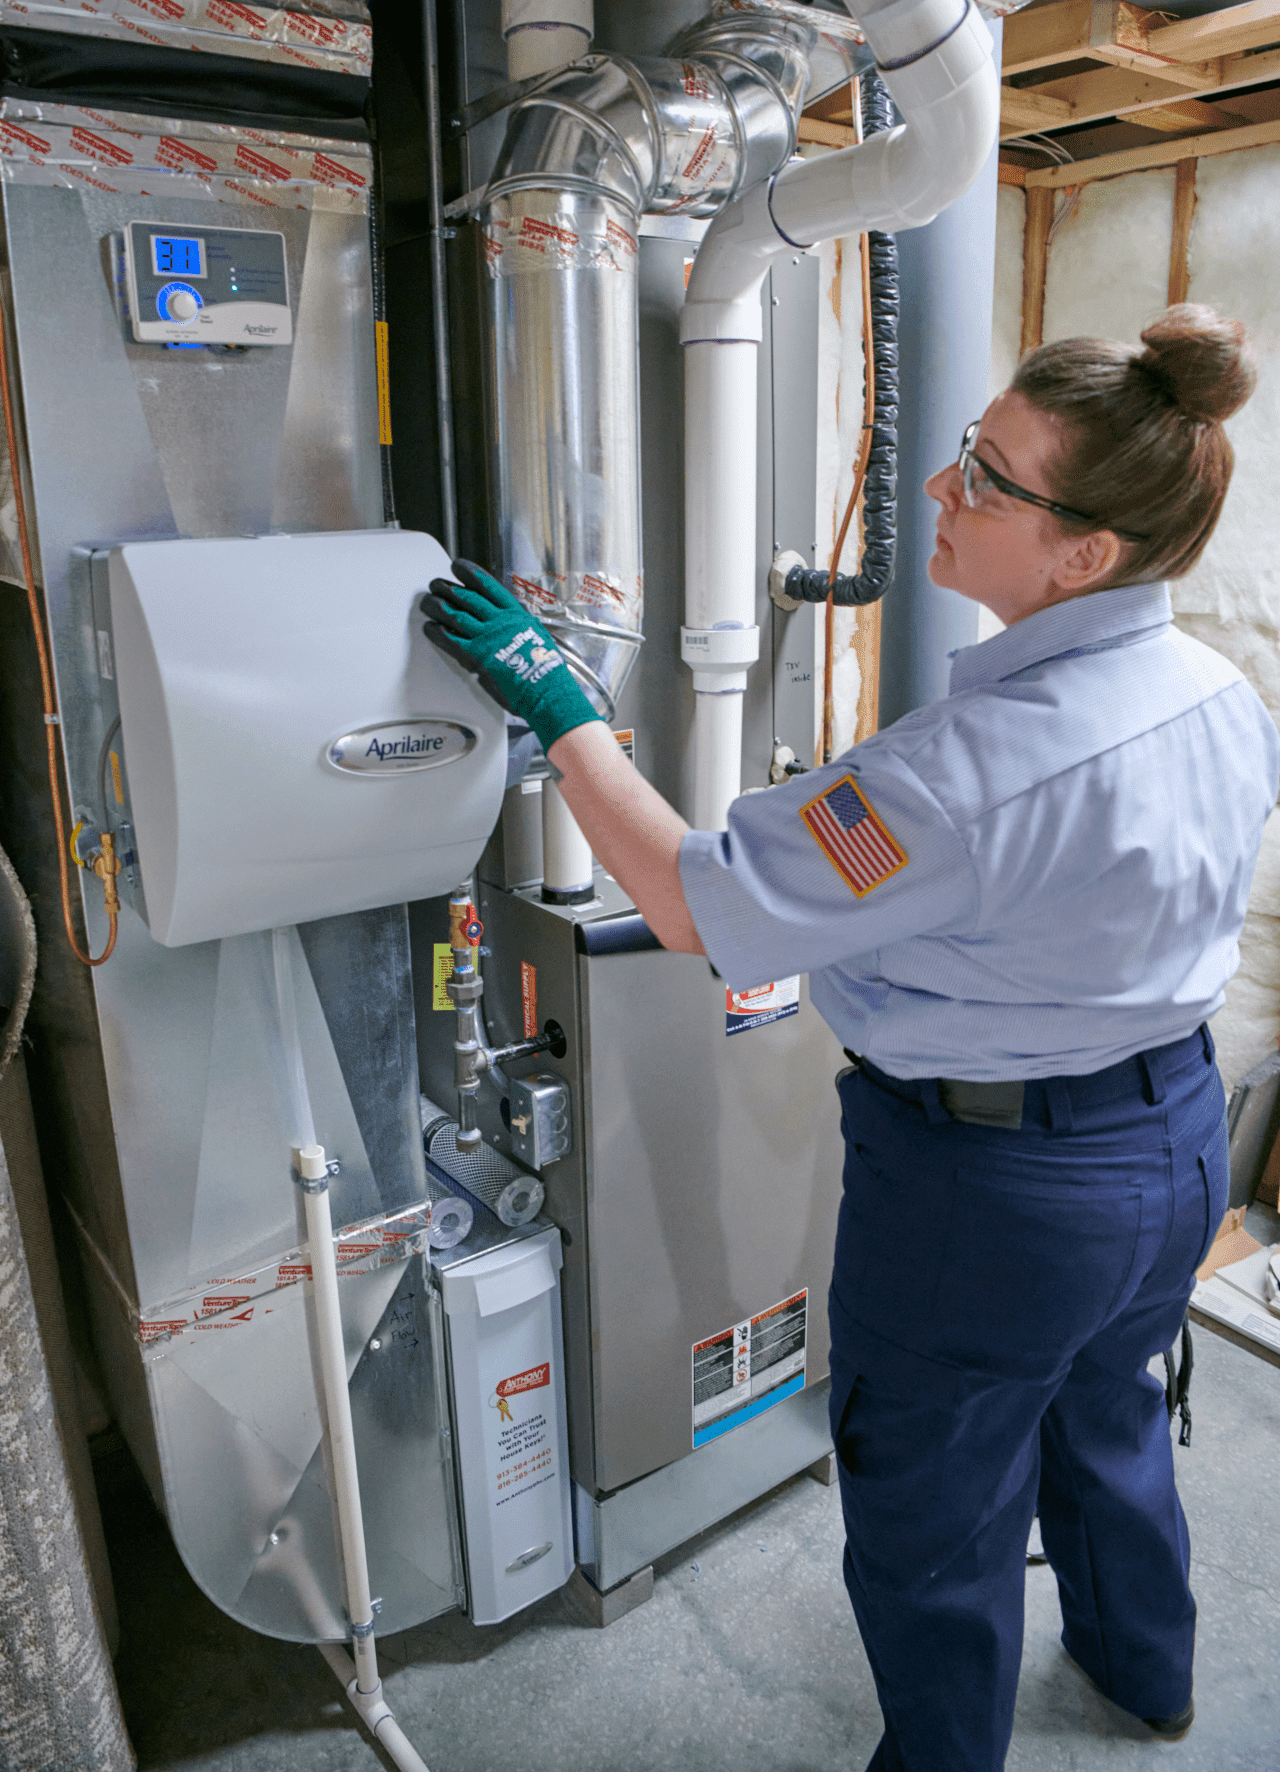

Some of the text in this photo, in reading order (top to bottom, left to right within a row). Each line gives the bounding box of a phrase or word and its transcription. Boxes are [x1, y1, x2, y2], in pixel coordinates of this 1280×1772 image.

[161, 240, 190, 272] 31
[365, 733, 444, 762] Aprilaire
[504, 1367, 547, 1390] ANTHONY
[497, 1419, 547, 1447] You Can Trust
[501, 1414, 543, 1437] Technicians
[505, 1430, 540, 1451] with Your
[500, 1448, 523, 1462] House
